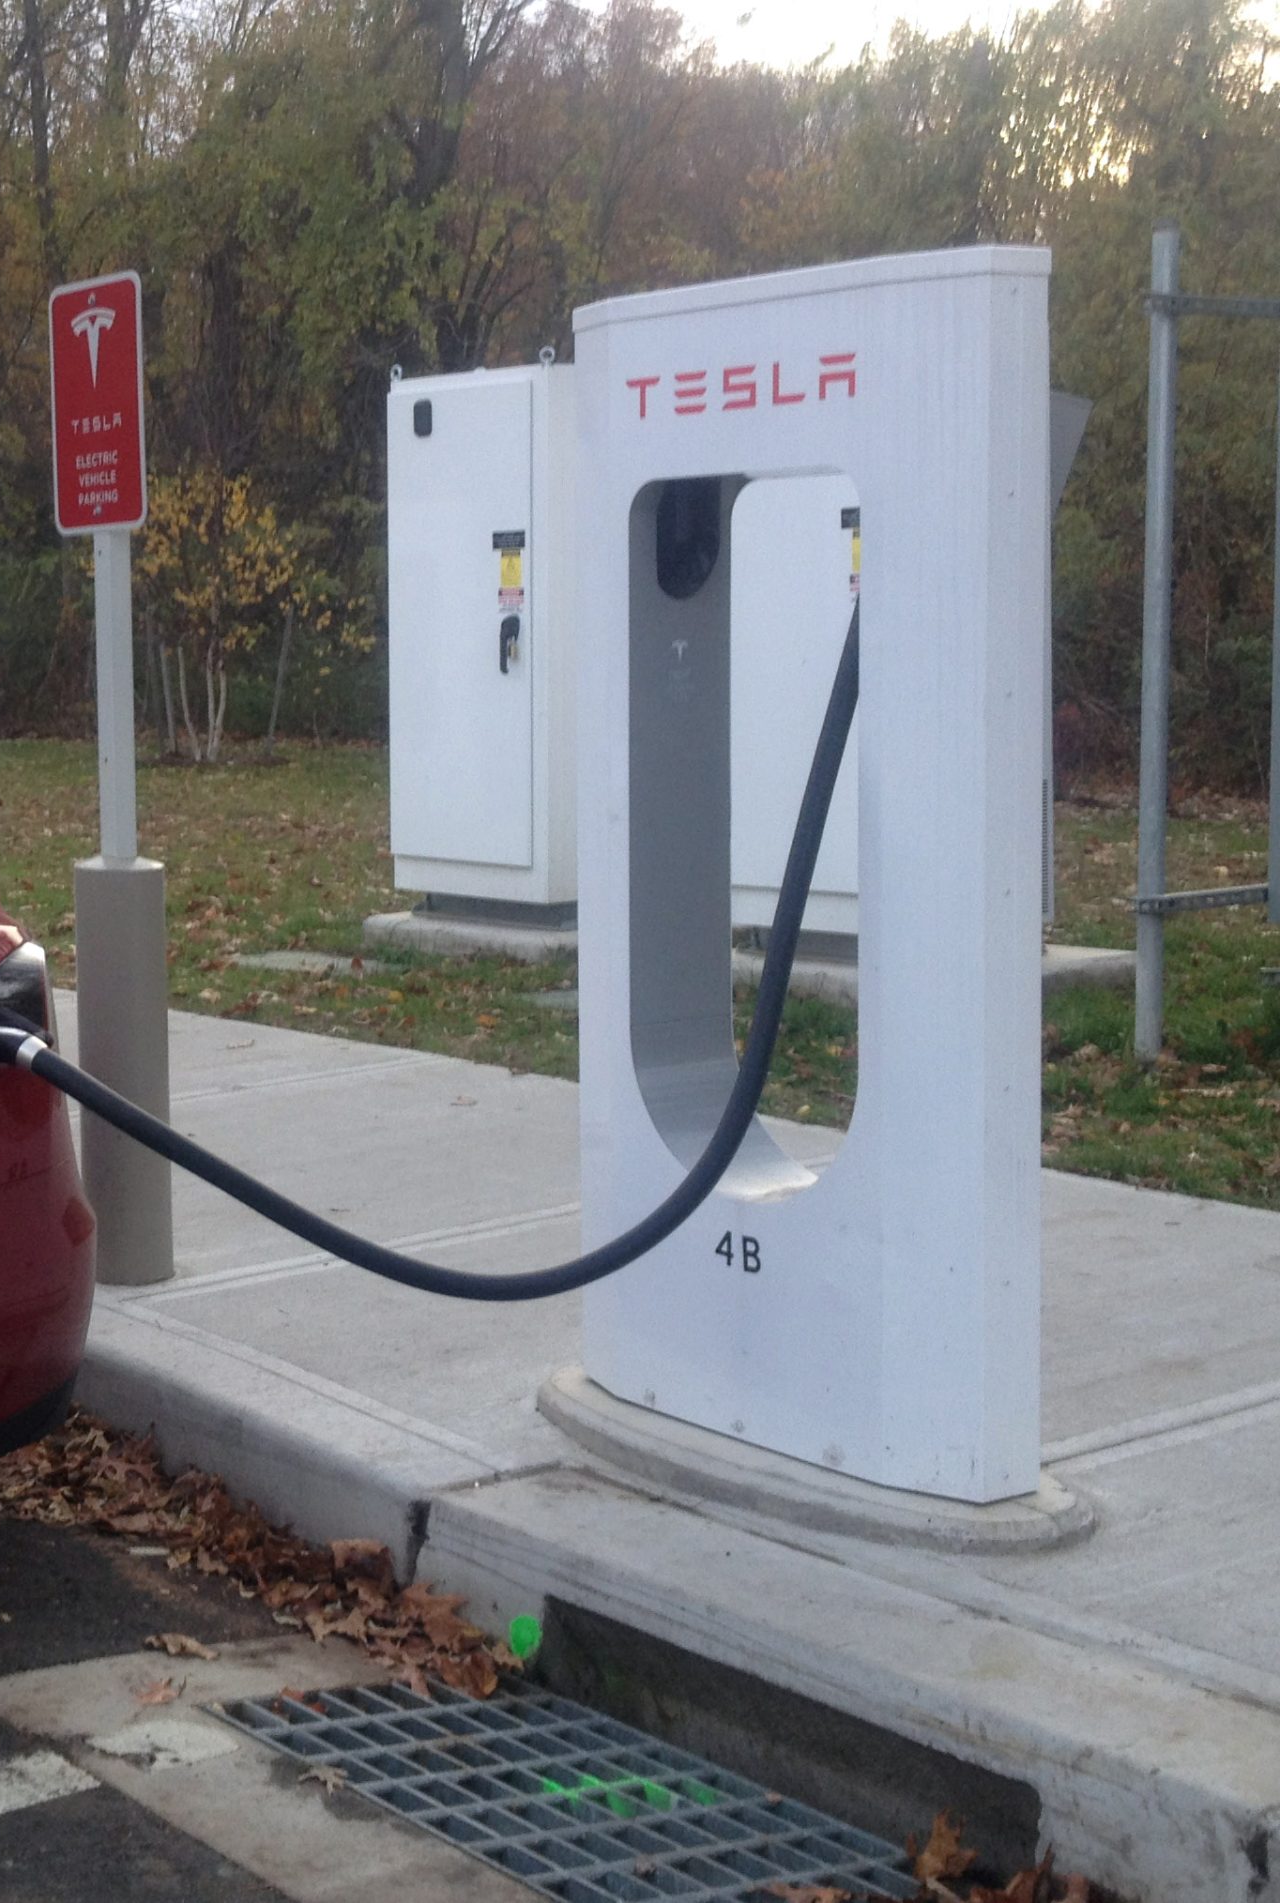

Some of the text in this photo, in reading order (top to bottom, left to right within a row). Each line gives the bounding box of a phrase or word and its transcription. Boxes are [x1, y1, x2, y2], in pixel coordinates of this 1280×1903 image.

[626, 352, 856, 420] TESLA
[71, 412, 122, 435] TESLA
[76, 449, 118, 470] ELECTRIC
[79, 469, 117, 488] VEHICLE
[78, 488, 118, 506] PARKING
[715, 1230, 761, 1273] 4B
